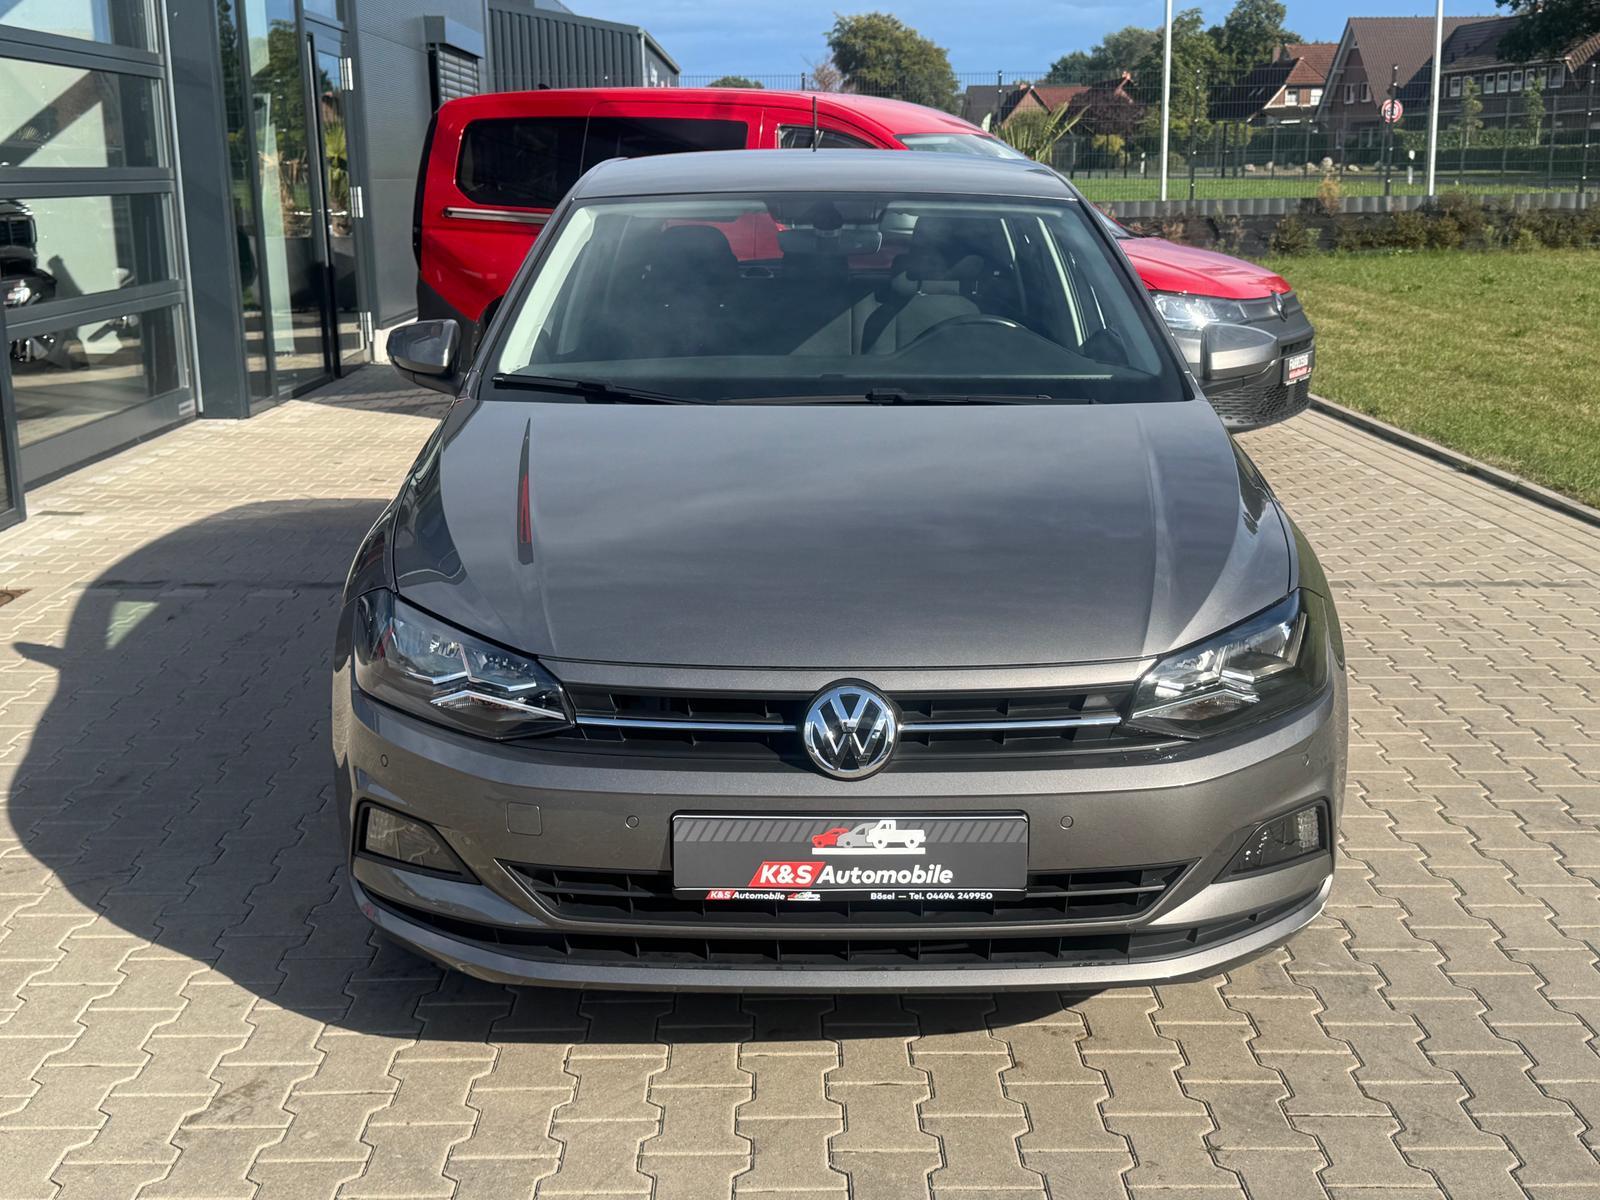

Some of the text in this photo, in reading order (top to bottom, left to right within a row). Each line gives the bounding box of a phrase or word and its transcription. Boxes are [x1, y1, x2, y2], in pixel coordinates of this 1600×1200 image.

[760, 864, 954, 885] K&S Automobile
[710, 890, 786, 900] K&S Automobile
[870, 891, 895, 900] Bösel
[909, 892, 925, 900] Tel.
[926, 892, 955, 900] 04494
[957, 892, 993, 900] 249950
